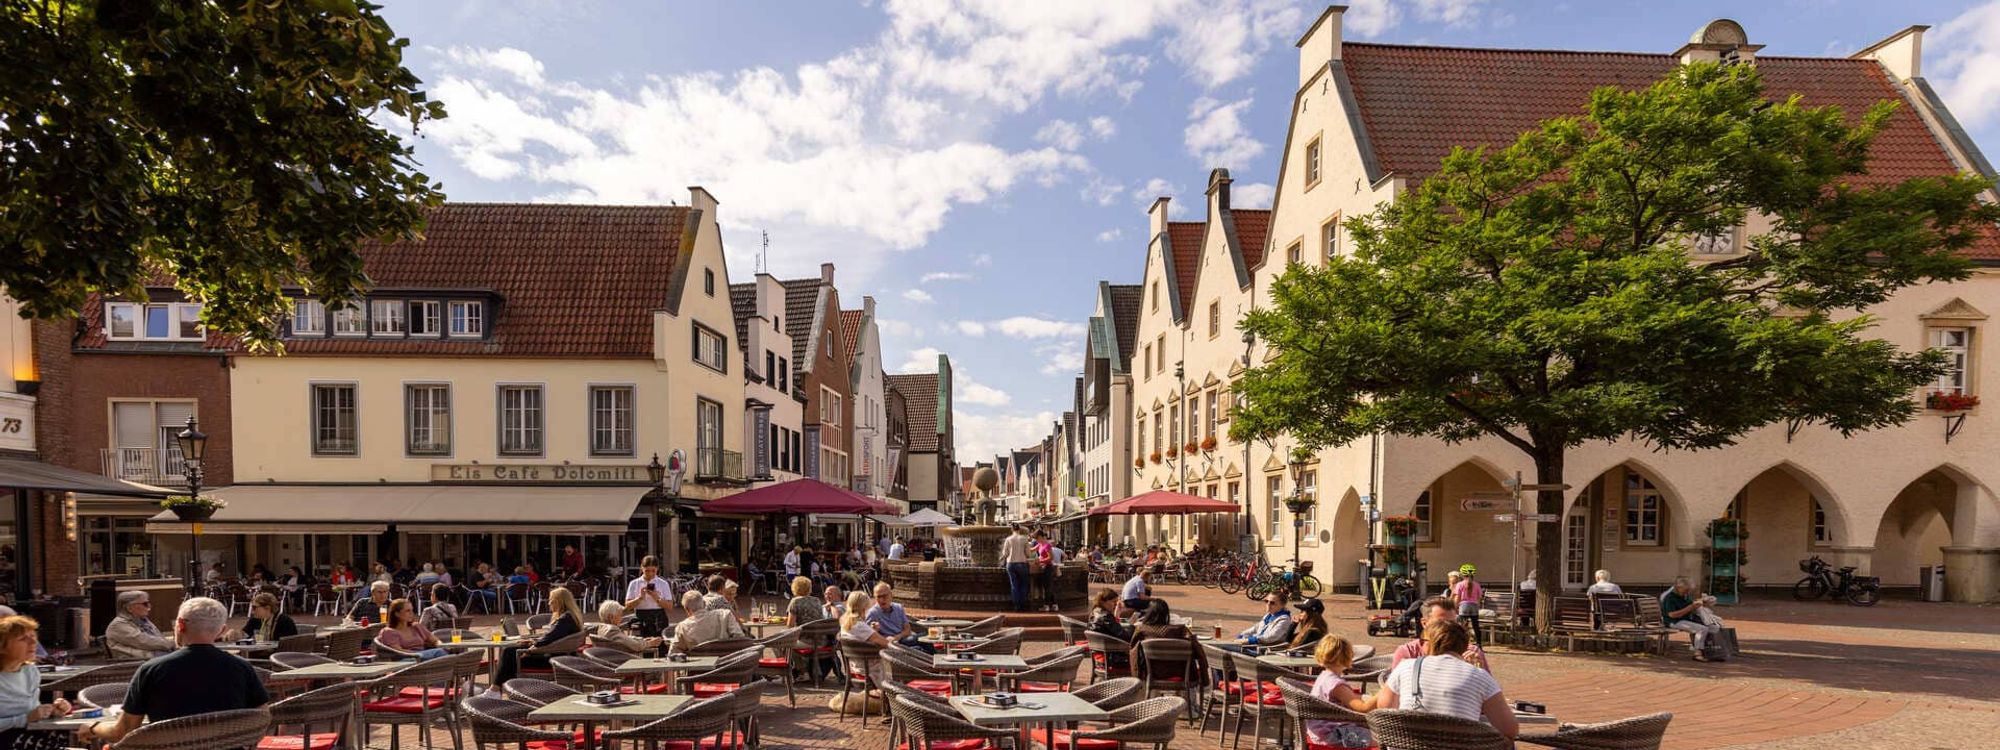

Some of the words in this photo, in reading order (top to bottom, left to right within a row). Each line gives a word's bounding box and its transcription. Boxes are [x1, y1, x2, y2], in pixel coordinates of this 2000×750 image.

[1, 417, 22, 433] 73
[449, 465, 481, 479] Eis
[493, 465, 540, 479] Café
[552, 465, 636, 479] Dolomiti
